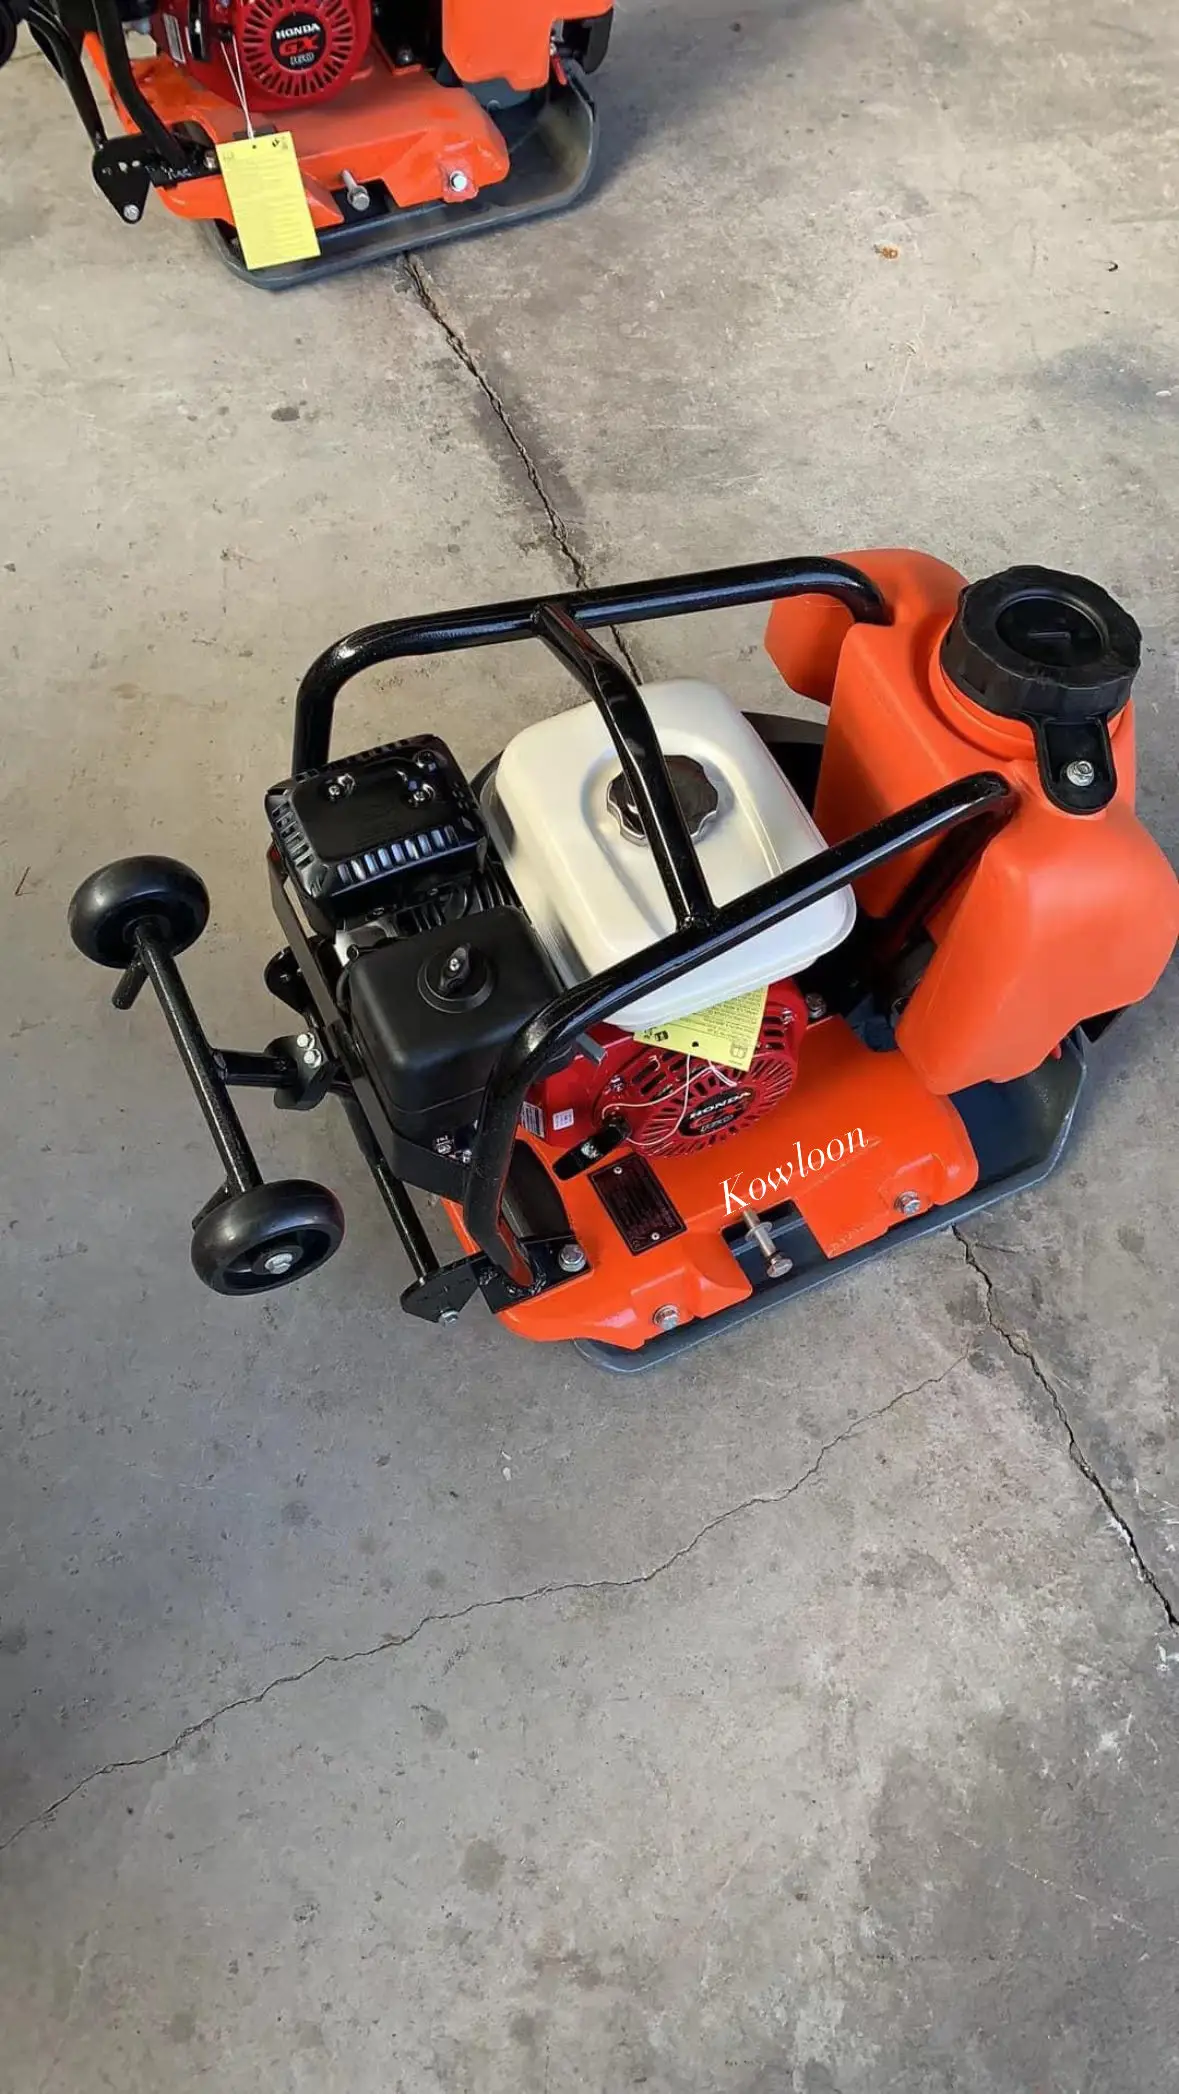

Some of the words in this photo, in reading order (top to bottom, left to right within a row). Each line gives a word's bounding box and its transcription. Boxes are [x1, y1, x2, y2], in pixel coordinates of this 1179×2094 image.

[275, 23, 321, 40] HONDA
[279, 34, 319, 56] GX
[689, 1092, 752, 1119] HONDA
